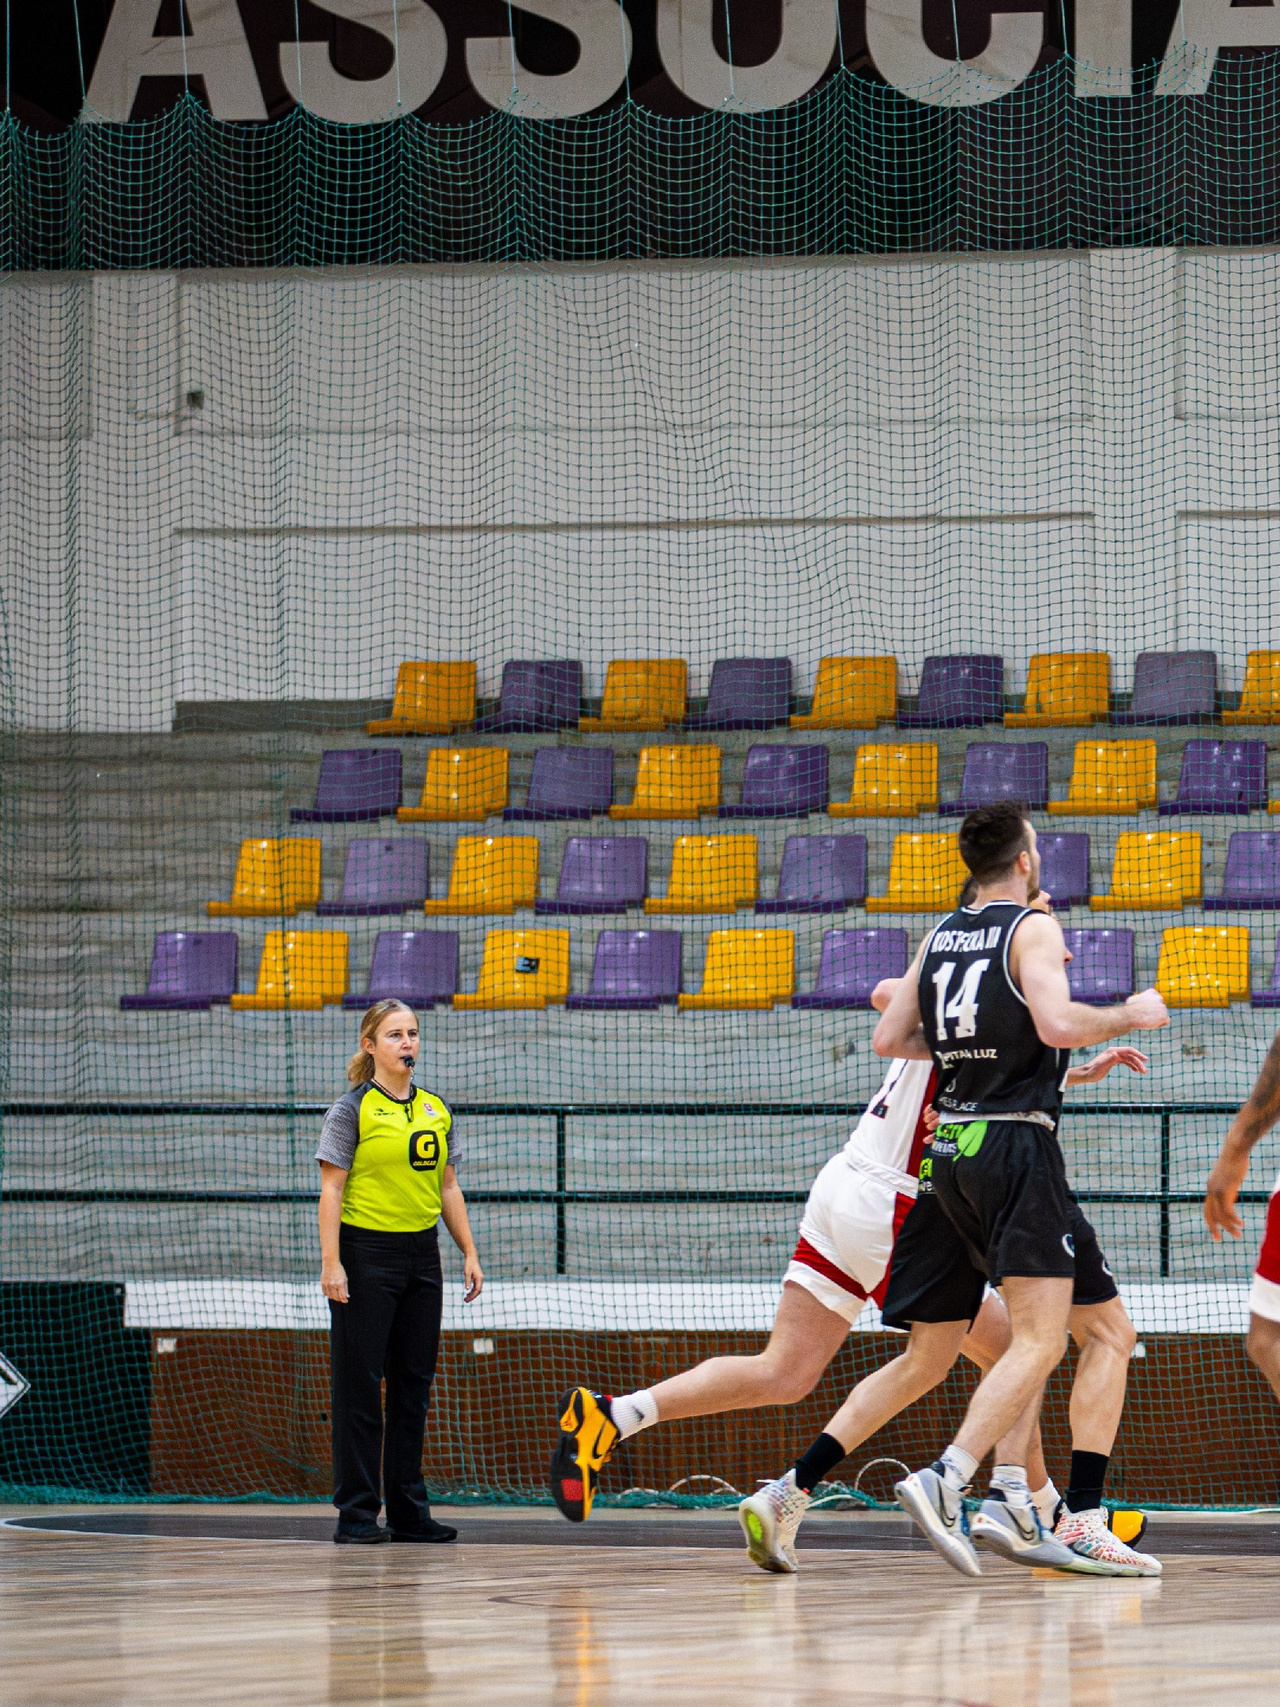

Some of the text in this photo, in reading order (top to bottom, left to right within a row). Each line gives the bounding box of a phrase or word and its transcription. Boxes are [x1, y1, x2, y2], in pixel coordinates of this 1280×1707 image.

[932, 959, 990, 1041] 14
[973, 1048, 998, 1059] LUZ
[416, 1134, 435, 1158] G
